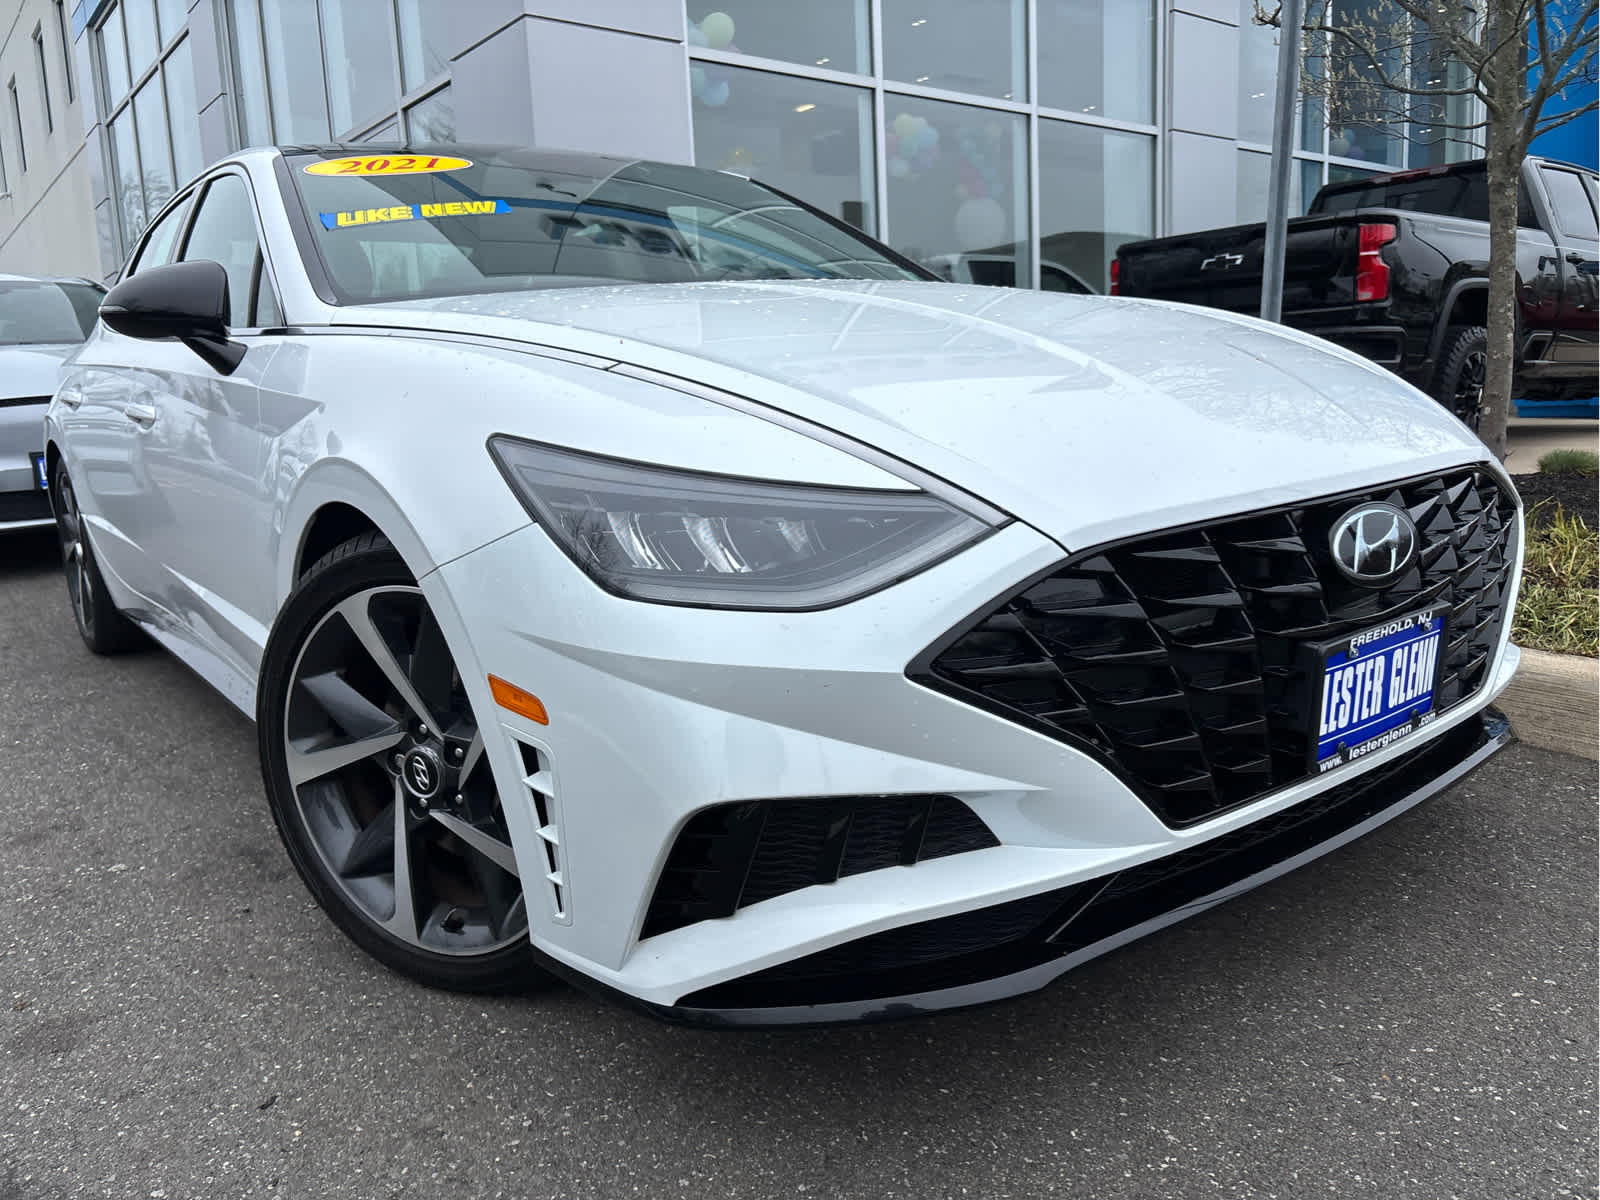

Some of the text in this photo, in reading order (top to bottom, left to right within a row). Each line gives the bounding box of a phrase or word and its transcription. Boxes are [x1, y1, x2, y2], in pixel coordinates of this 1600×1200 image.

[338, 158, 440, 174] 2021
[337, 201, 496, 227] LIKE NEW
[1350, 611, 1433, 650] FREEHOLD, NJ
[1319, 634, 1440, 737] LESTER GLENN
[1349, 724, 1413, 760] lesterglenn
